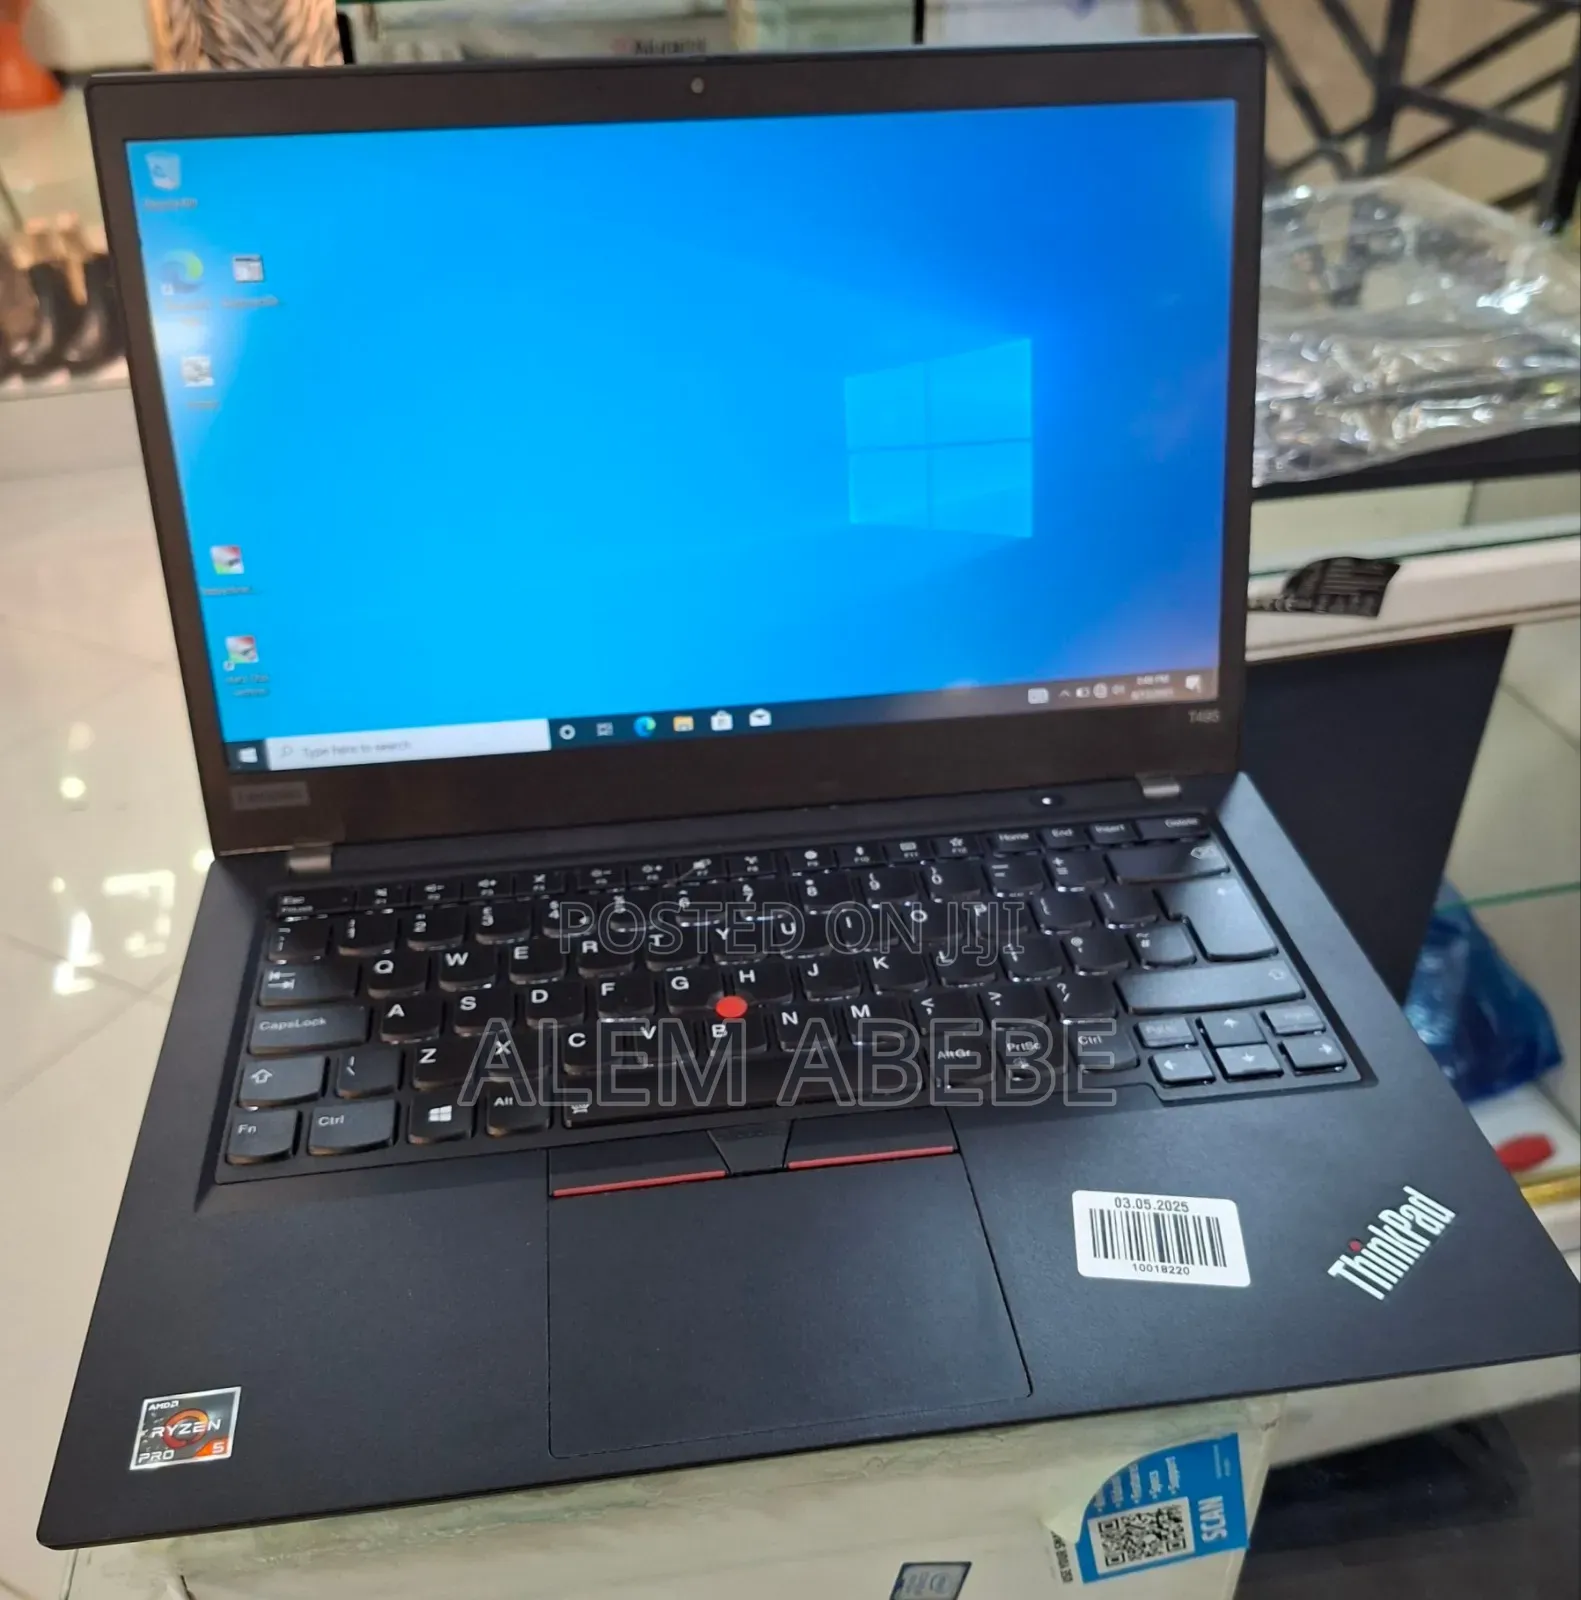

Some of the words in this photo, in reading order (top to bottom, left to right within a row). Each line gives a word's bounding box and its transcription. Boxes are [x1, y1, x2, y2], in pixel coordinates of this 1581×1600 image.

[1052, 828, 1073, 838] End
[1094, 823, 1126, 834] Insert
[998, 832, 1030, 842] Home
[911, 909, 928, 923] O
[973, 903, 987, 916] P
[716, 927, 730, 940] Y
[781, 921, 796, 935] U
[582, 940, 599, 954] R
[649, 934, 664, 947] T
[445, 951, 469, 966] W
[514, 946, 529, 960] E
[374, 960, 394, 974] Q
[807, 963, 820, 977] J
[872, 956, 889, 970] K
[671, 976, 690, 990] G
[738, 969, 756, 983] H
[600, 982, 616, 996] F
[460, 996, 477, 1011] S
[531, 989, 549, 1004] D
[387, 1004, 405, 1018] A
[781, 1011, 799, 1025] N
[850, 1004, 871, 1018] M
[259, 1017, 327, 1030] CapsLock
[640, 1025, 656, 1039] V
[712, 1024, 728, 1038] B
[568, 1033, 586, 1047] C
[1078, 1034, 1102, 1045] Ctrl
[495, 1040, 511, 1055] X
[937, 1048, 971, 1060] AltGr
[1006, 1041, 1041, 1053] PrtSc
[419, 1048, 437, 1064] Z
[494, 1096, 513, 1107] Alt
[318, 1115, 345, 1127] Ctrl
[237, 1124, 257, 1135] Fn
[1114, 1197, 1190, 1213] 03.05.2025
[1327, 1185, 1456, 1300] ThinkPad
[1132, 1263, 1191, 1276] 10018220
[148, 1400, 175, 1411] AMD
[151, 1419, 221, 1438] RYZEN
[211, 1441, 225, 1454] 5
[138, 1449, 175, 1463] PRO
[1198, 1496, 1228, 1543] SCAN
